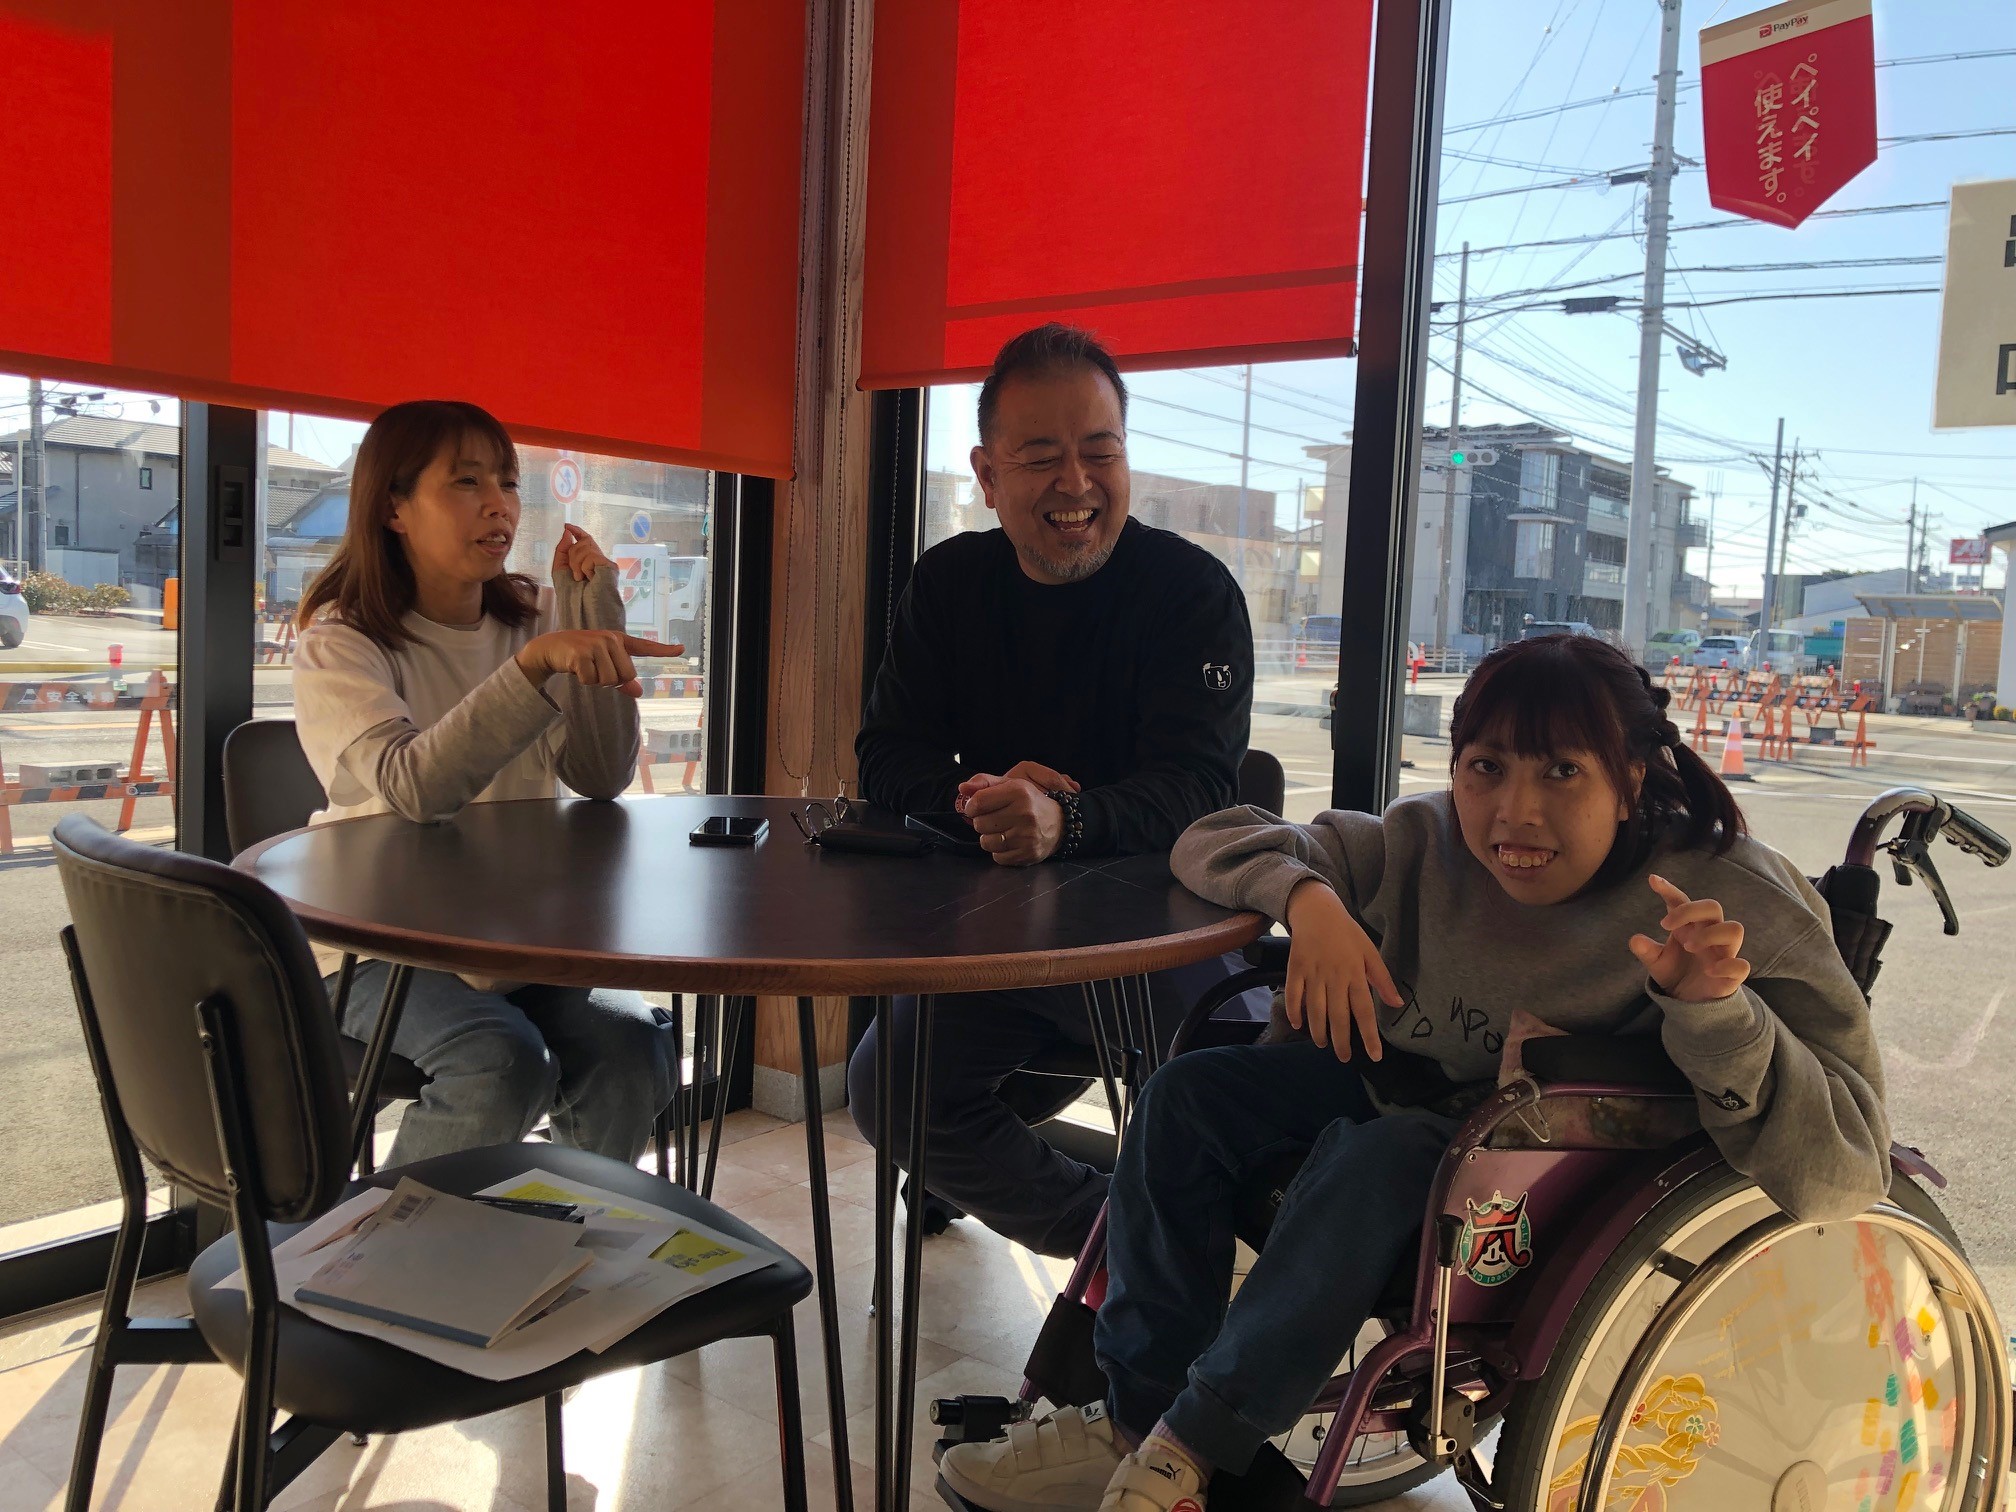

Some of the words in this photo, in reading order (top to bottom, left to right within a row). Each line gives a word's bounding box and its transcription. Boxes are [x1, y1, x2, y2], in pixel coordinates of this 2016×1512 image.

[1773, 15, 1809, 33] PayPay
[1754, 82, 1787, 203] 使えます。
[1790, 53, 1820, 161] ペイペイ
